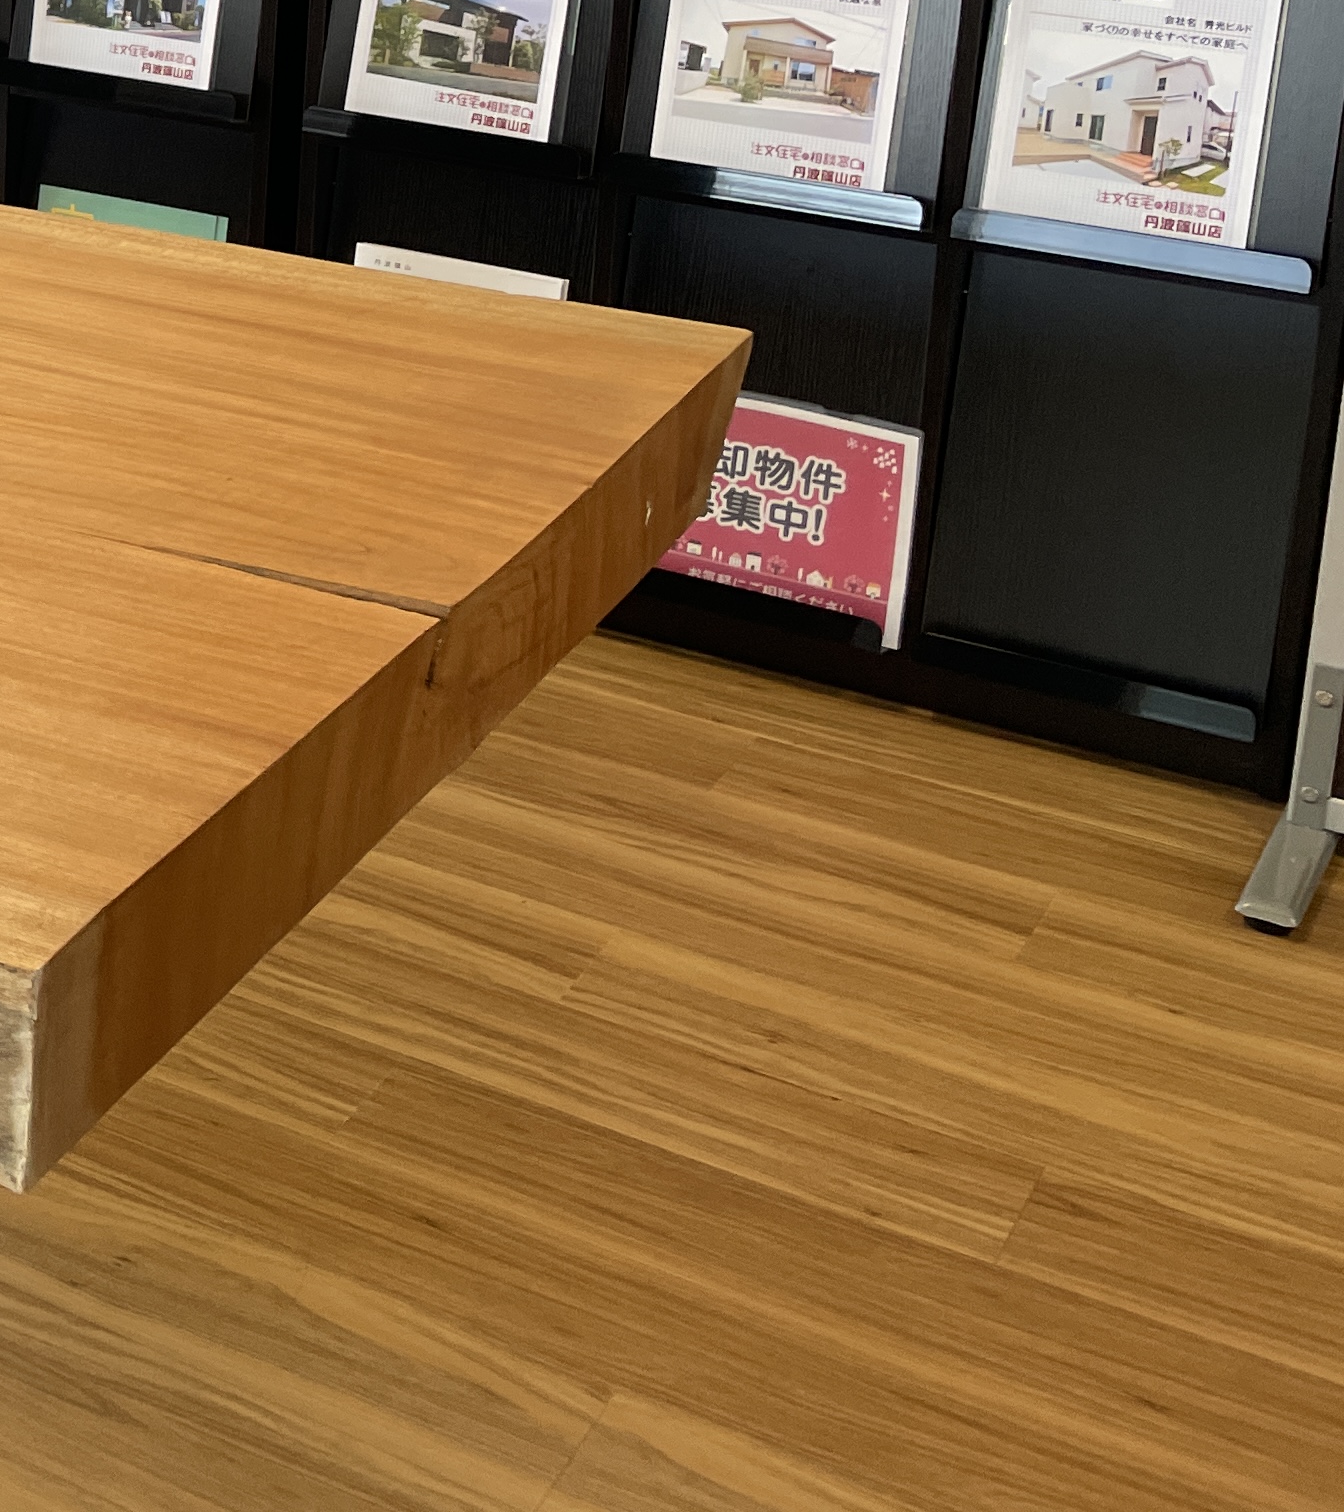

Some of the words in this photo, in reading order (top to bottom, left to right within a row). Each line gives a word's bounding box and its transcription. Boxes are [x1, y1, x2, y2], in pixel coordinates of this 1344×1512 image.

[1164, 15, 1197, 28] 会社名
[706, 482, 823, 543] 集中！
